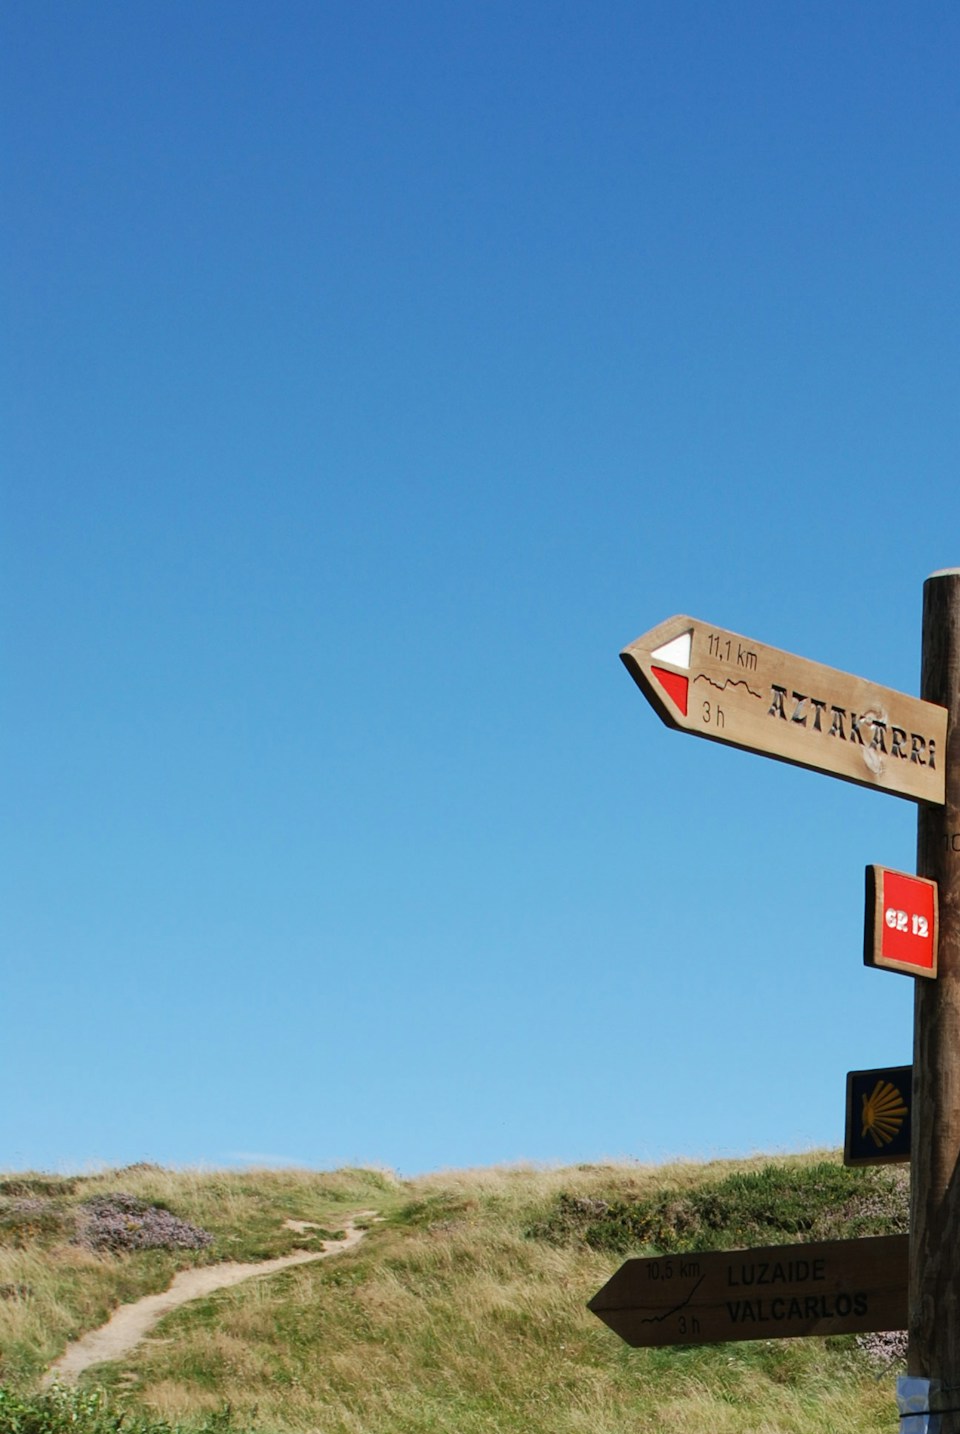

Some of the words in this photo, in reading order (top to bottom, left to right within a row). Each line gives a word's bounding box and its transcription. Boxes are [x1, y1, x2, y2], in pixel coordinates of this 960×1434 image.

[707, 633, 732, 662] 11,1
[737, 648, 758, 671] km
[885, 907, 908, 933] GR
[911, 914, 929, 938] 12
[645, 1261, 674, 1282] 10,5
[679, 1259, 700, 1278] km
[727, 1258, 826, 1287] LUZAIDE
[726, 1291, 869, 1323] VALCARLOS
